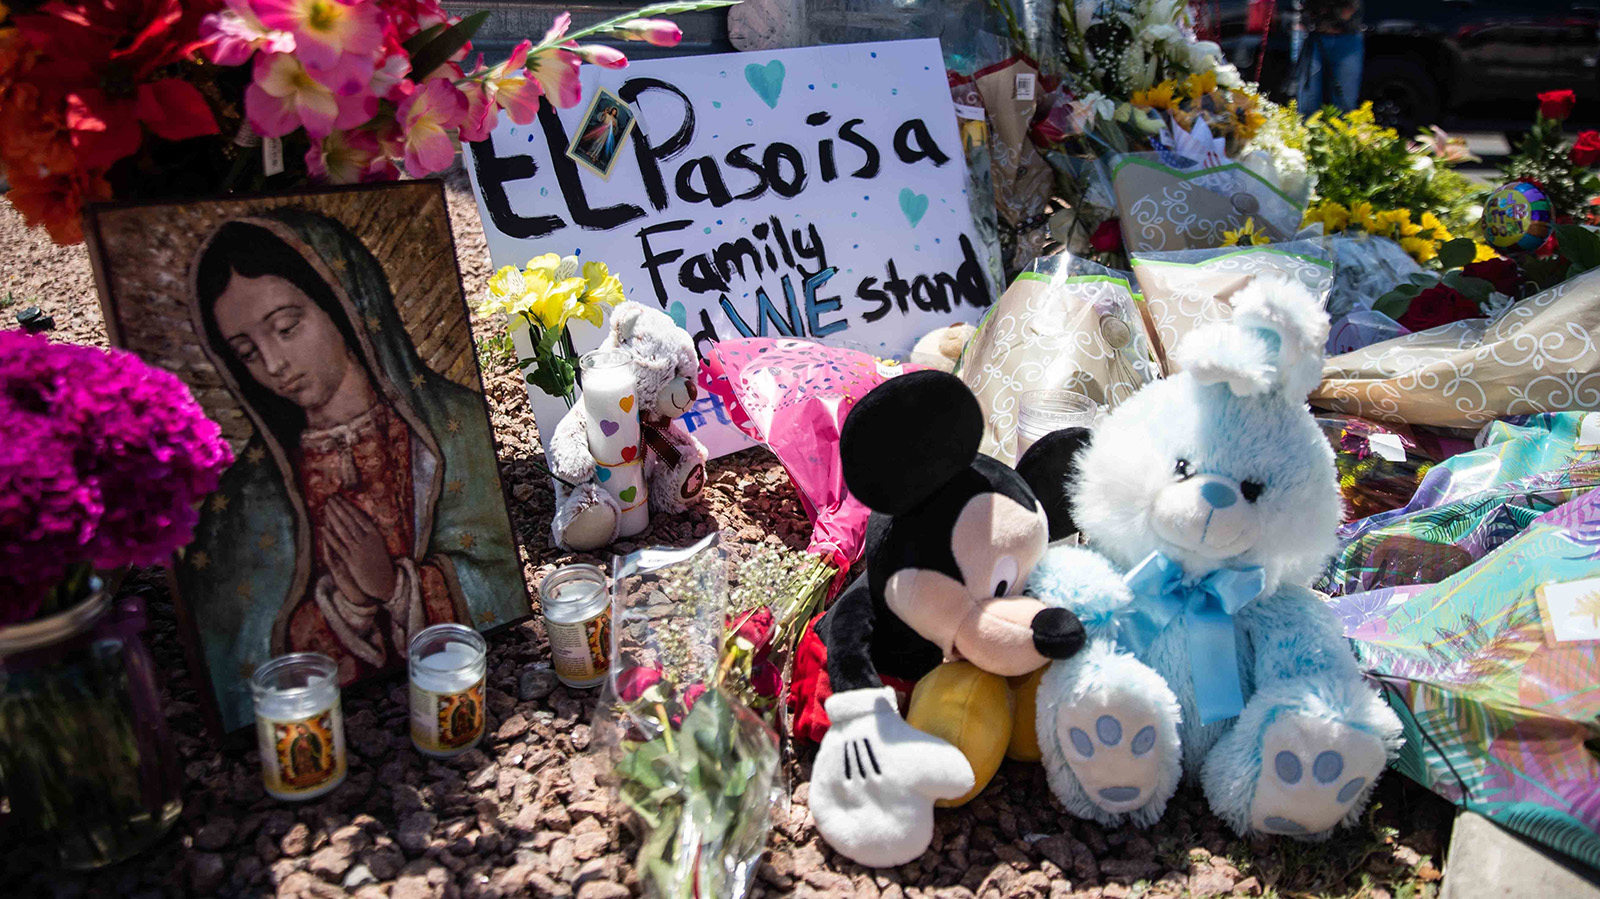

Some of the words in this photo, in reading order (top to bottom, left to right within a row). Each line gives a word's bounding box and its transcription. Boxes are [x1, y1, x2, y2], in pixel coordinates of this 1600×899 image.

[618, 77, 809, 213] Paso
[806, 110, 881, 183] is
[893, 118, 951, 168] a
[635, 215, 829, 309] Family
[719, 266, 850, 338] WE
[855, 233, 993, 324] stand
